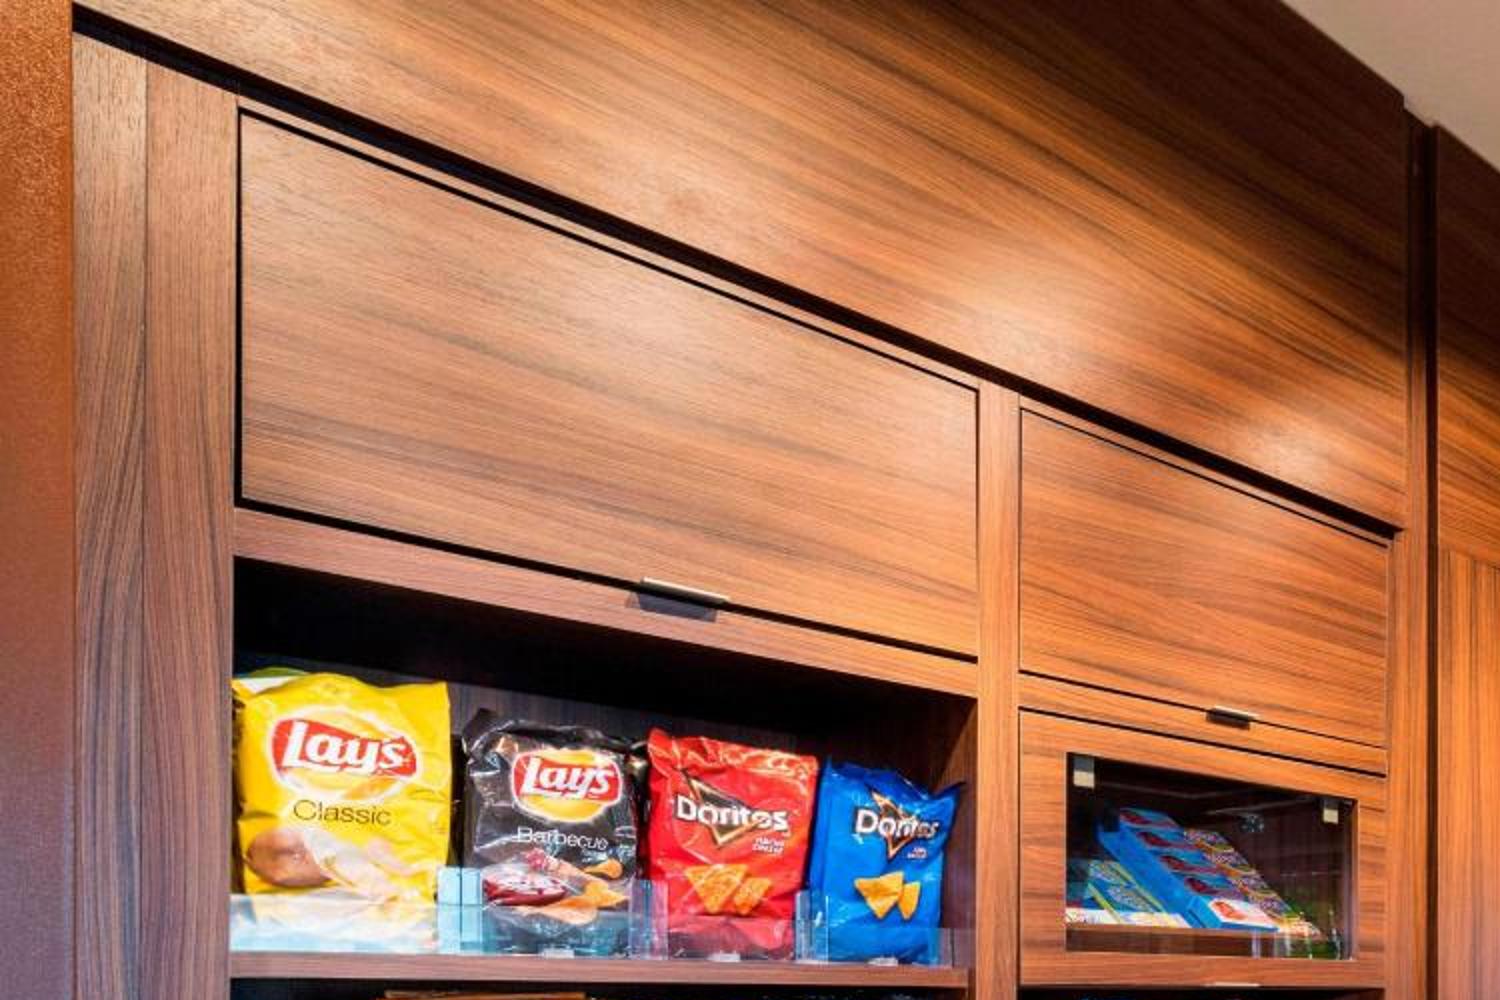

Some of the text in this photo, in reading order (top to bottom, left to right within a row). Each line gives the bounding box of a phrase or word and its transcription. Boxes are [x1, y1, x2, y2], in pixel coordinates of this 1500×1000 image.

[281, 720, 408, 777] Lay's
[518, 757, 614, 800] Lay's
[293, 798, 391, 826] Classic
[676, 794, 790, 832] Doritos
[515, 826, 609, 852] Barbecue
